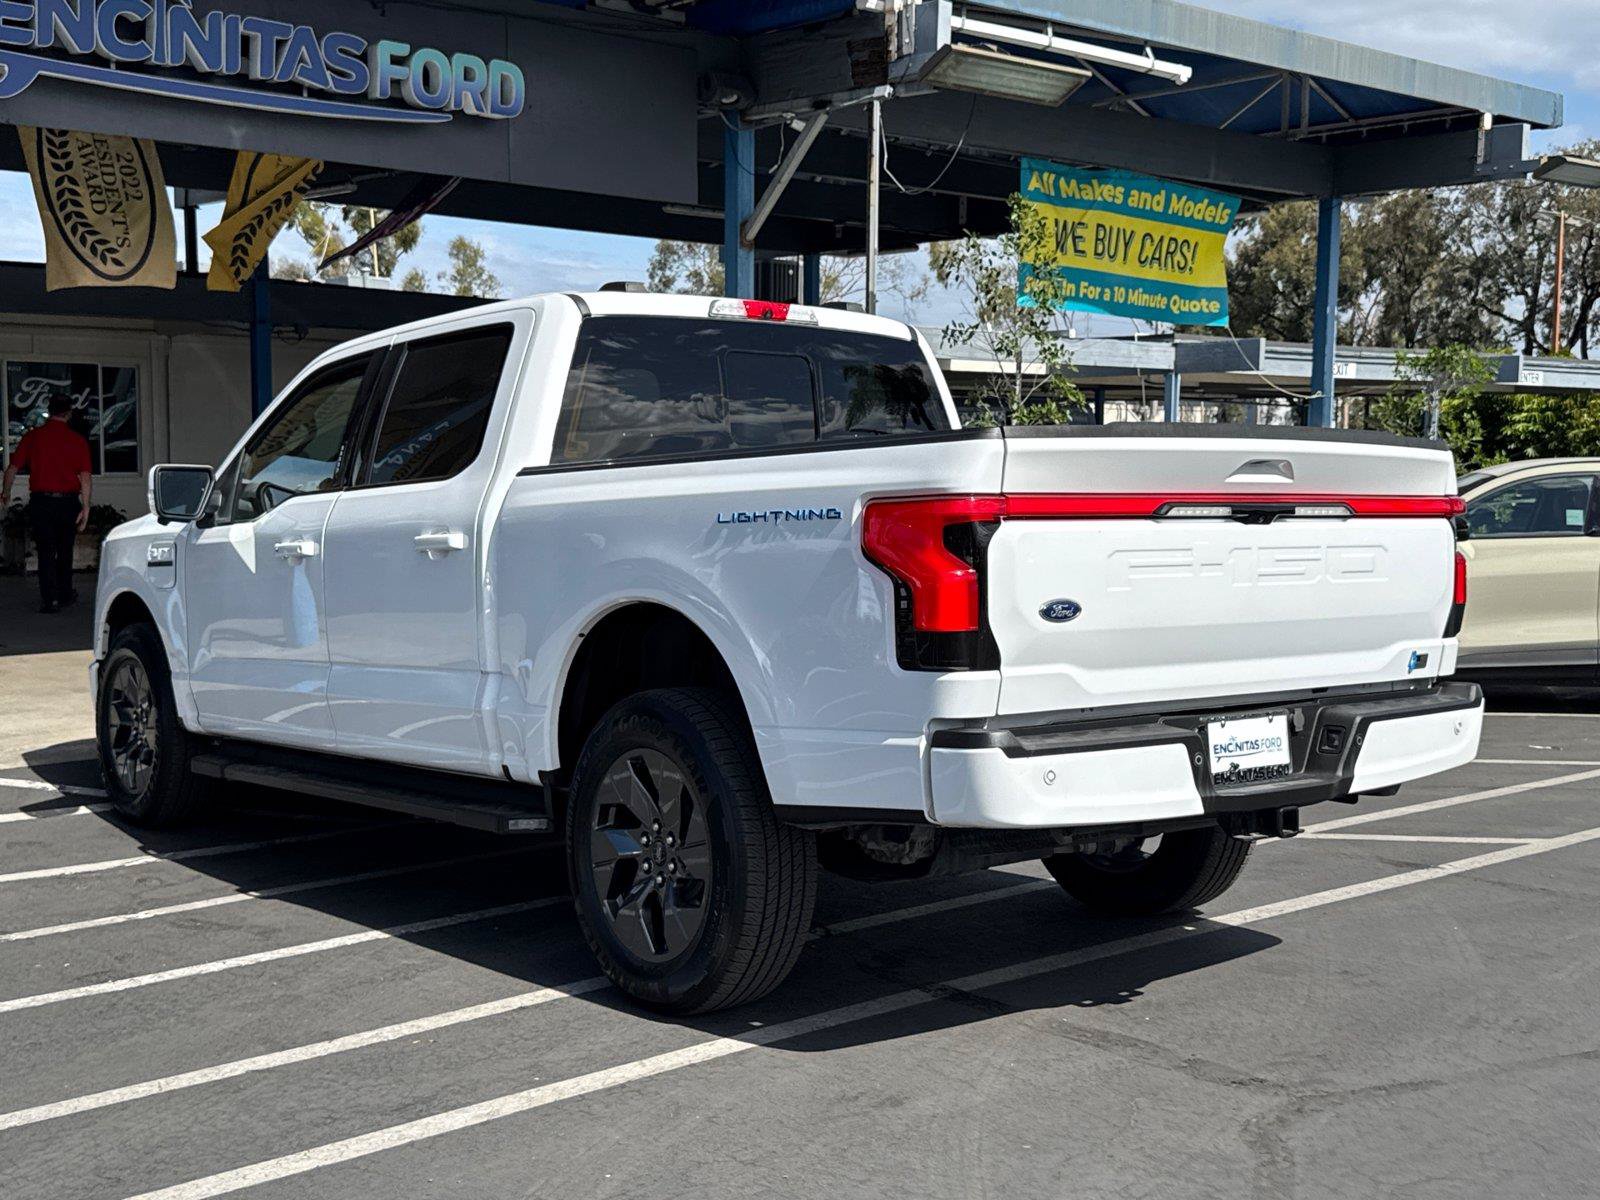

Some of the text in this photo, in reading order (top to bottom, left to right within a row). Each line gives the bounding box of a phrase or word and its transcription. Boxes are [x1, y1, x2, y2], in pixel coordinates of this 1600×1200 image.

[370, 39, 525, 119] FORD
[76, 138, 108, 215] AWARD
[92, 135, 131, 248] ESIDENT'S
[116, 152, 144, 201] 2022
[1028, 170, 1232, 225] All Makes and Models
[1054, 218, 1199, 275] WE BUY CARS!
[1079, 281, 1101, 300] For
[1103, 288, 1111, 302] a
[1114, 286, 1124, 304] 10
[1128, 288, 1168, 310] Minute
[1169, 295, 1221, 314] Quote
[14, 376, 100, 410] Fod
[717, 508, 842, 526] LIGHTNING
[1260, 736, 1282, 749] FORD
[1214, 766, 1264, 784] ENCNITAS
